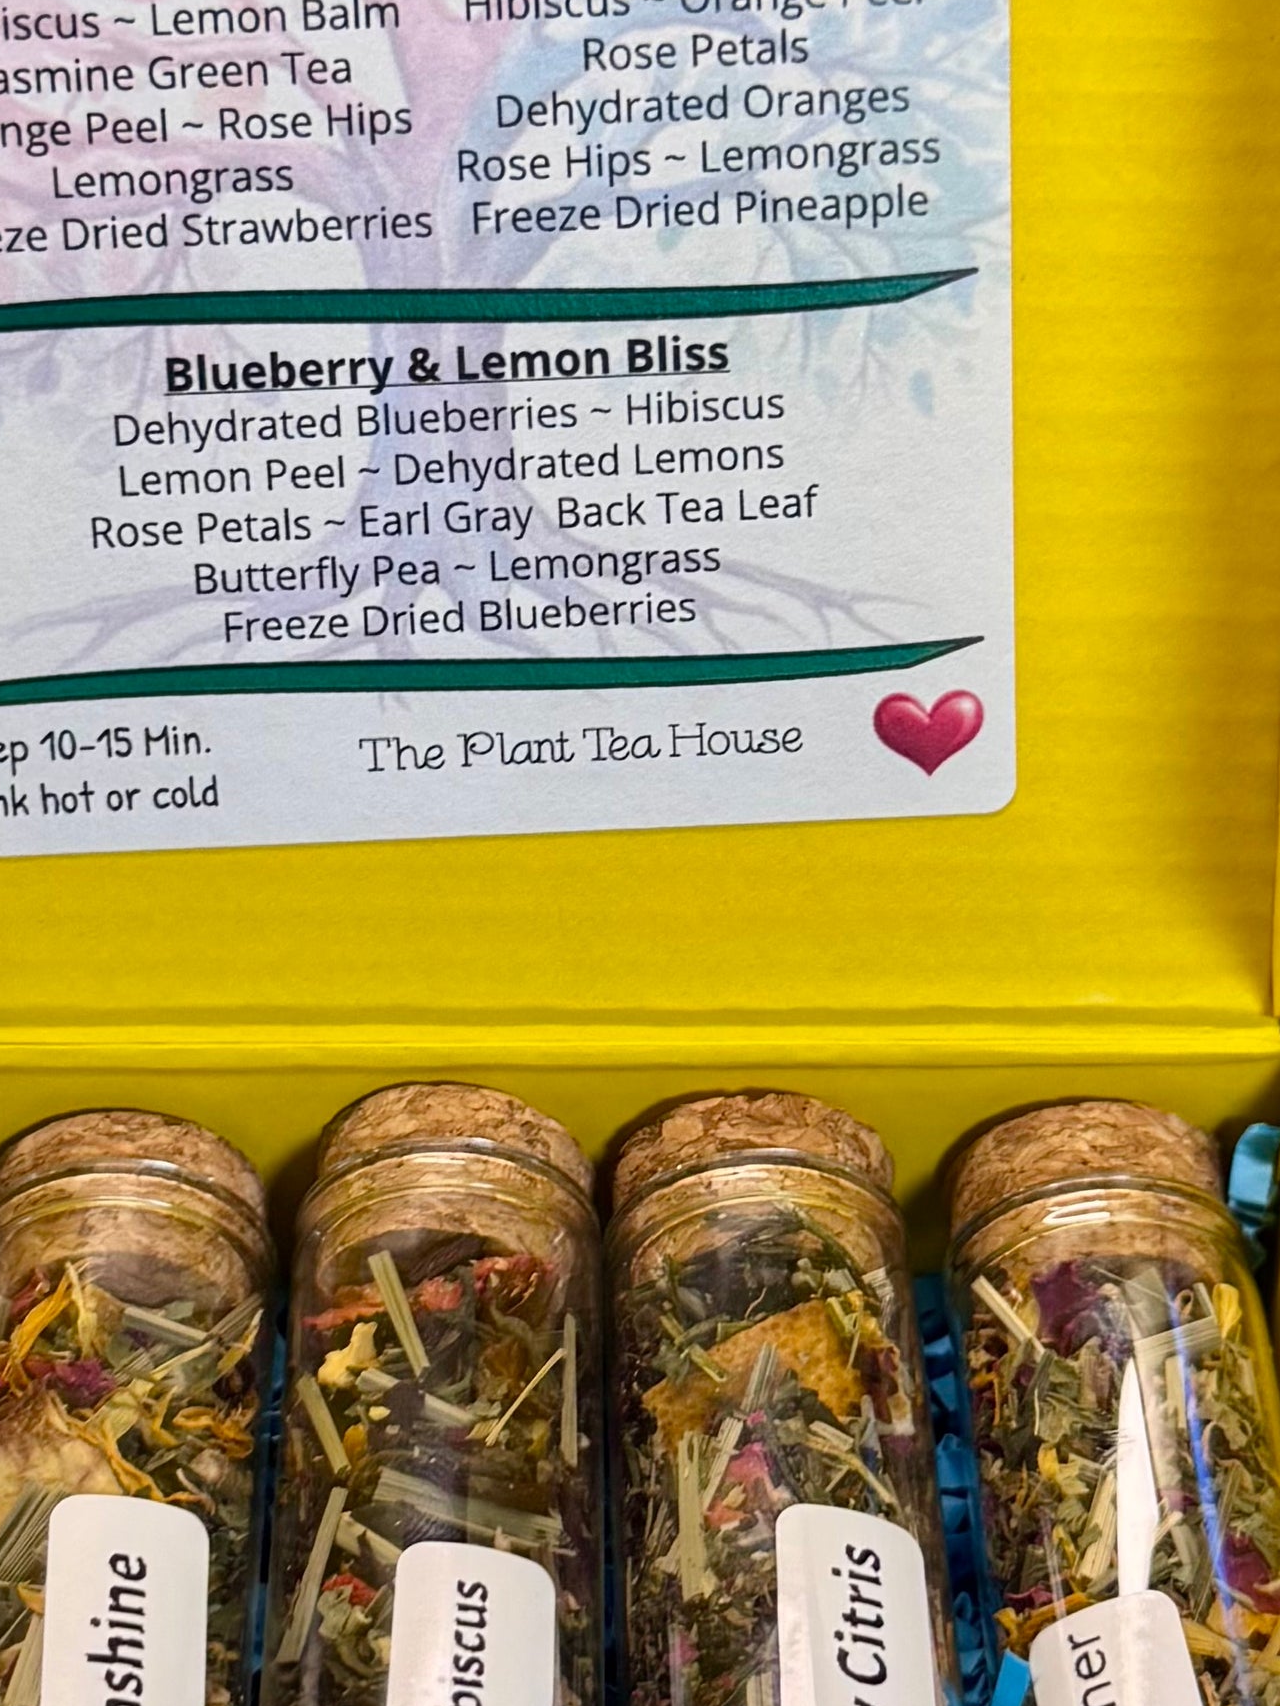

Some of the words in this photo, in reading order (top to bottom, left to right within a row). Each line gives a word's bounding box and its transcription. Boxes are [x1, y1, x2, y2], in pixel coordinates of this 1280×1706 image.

[149, 1, 288, 38] Lemon
[146, 54, 270, 92] Green
[278, 50, 353, 87] Tea
[581, 36, 678, 73] Rose
[690, 26, 811, 69] Petals
[85, 106, 169, 147] Peel
[217, 106, 314, 142] Rose
[325, 101, 414, 147] Hips
[495, 82, 730, 137] Dehydrated
[742, 82, 911, 126] Oranges
[51, 164, 295, 206] Lemongrass
[456, 147, 552, 184] Rose
[564, 143, 653, 189] Hips
[700, 136, 942, 180] Lemongrass
[60, 211, 170, 252] Dried
[180, 206, 434, 248] Strawberries
[471, 199, 603, 237] Freeze
[614, 187, 721, 231] Dried
[734, 181, 930, 231] Pineapple
[164, 349, 394, 396] Blueberry
[405, 347, 442, 387] &
[455, 341, 612, 386] Lemon
[625, 337, 730, 380] Bliss
[112, 402, 343, 455] Dehydrated
[355, 398, 579, 438] Blueberries
[625, 389, 786, 427] Hibiscus
[117, 463, 253, 499] Lemon
[264, 453, 346, 493] Peel
[393, 441, 621, 494] Dehydrated
[633, 442, 786, 477] Lemons
[89, 515, 185, 551] Rose
[196, 506, 313, 546] Petals
[358, 500, 431, 539] Earl
[442, 499, 535, 542] Gray
[556, 491, 648, 531] Back
[654, 490, 725, 526] Tea
[737, 482, 821, 522] Leaf
[192, 554, 361, 600] Butterfly
[372, 553, 442, 589] Pea
[488, 546, 723, 587] Lemongrass
[223, 610, 350, 645] Freeze
[361, 598, 466, 639] Dried
[478, 593, 698, 633] Blueberries
[38, 725, 134, 763] 10-15
[142, 723, 213, 758] Min.
[357, 735, 447, 774] The
[455, 729, 577, 769] Plant
[581, 725, 663, 763] Tea
[666, 720, 805, 759] House
[38, 779, 97, 816] hot
[104, 786, 143, 814] or
[151, 772, 221, 811] cold
[832, 1543, 888, 1687] Citris
